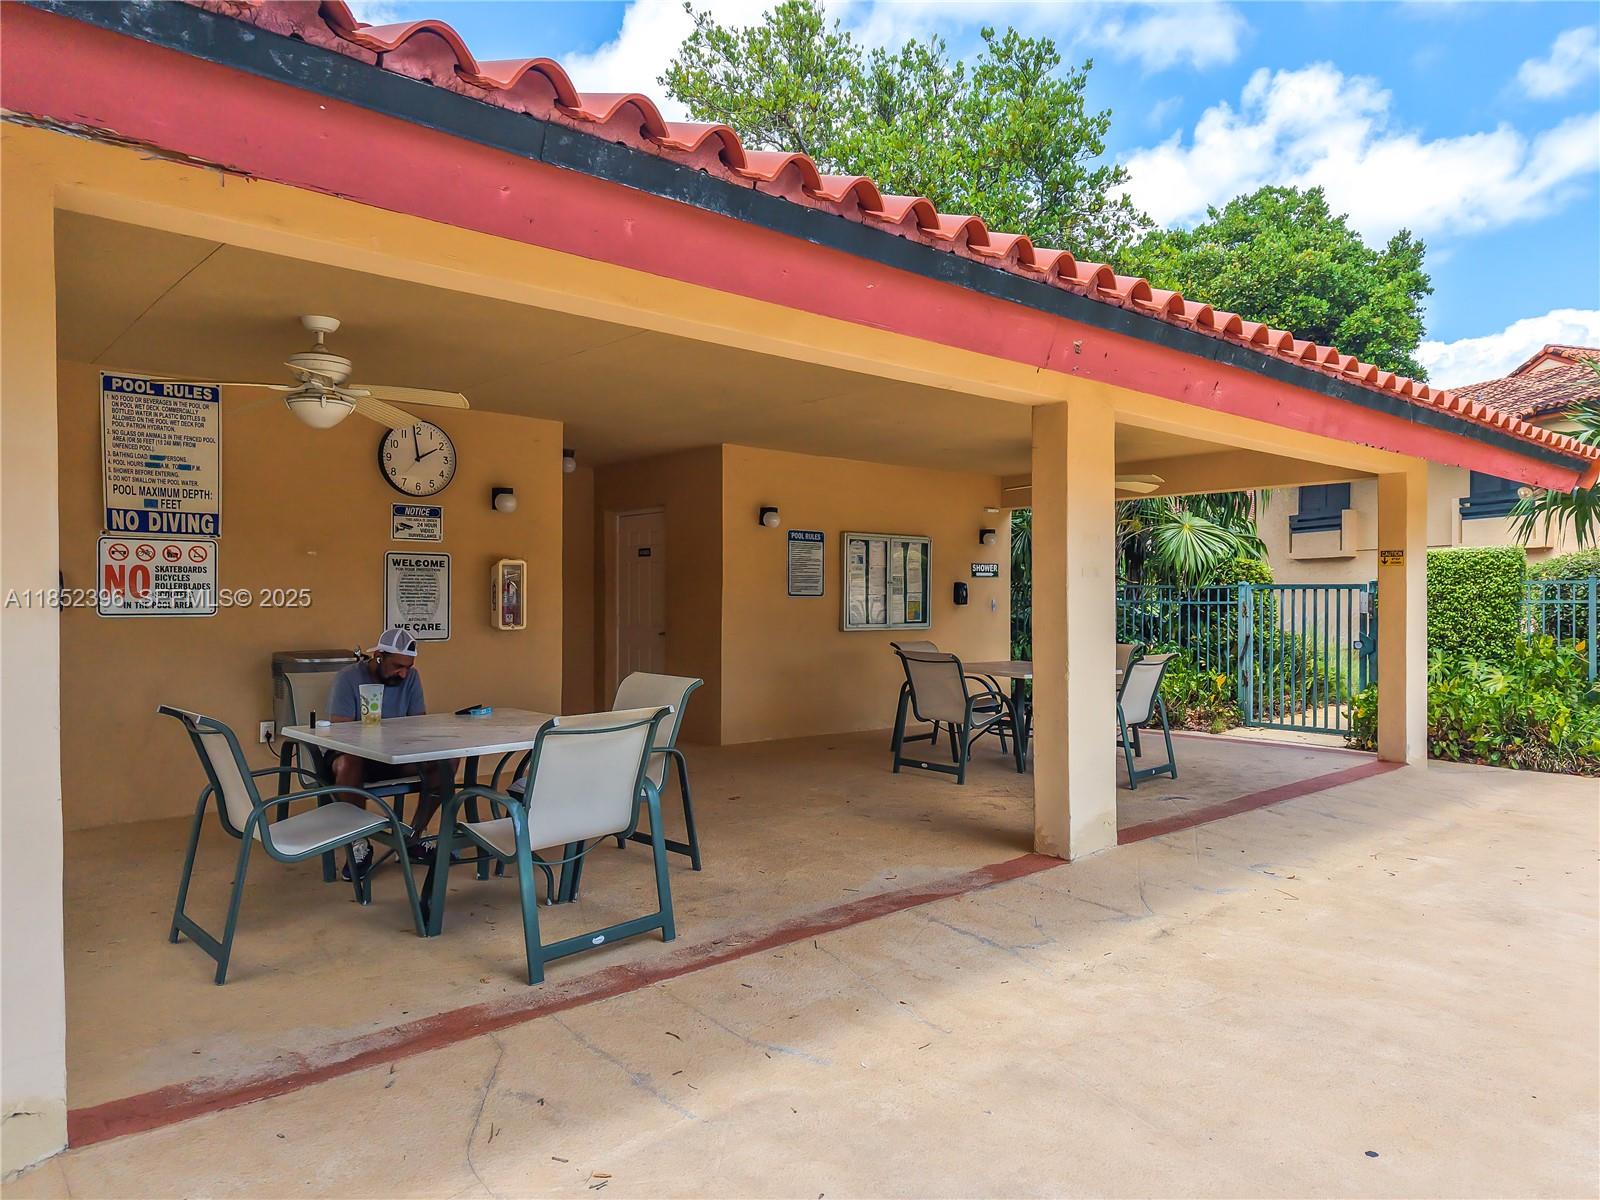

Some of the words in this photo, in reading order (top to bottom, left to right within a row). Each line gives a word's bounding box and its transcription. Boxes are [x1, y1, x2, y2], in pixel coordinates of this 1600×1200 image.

[112, 378, 154, 394] POOL
[164, 384, 212, 400] RULES
[143, 398, 171, 406] BEVERAGES
[162, 406, 198, 414] COMMERCIALLY
[401, 430, 407, 438] 11
[390, 440, 399, 449] 10
[439, 442, 444, 451] 2
[386, 453, 392, 461] 9
[443, 456, 449, 464] 3
[391, 467, 396, 476] 8
[439, 470, 444, 478] 4
[402, 478, 407, 486] 7
[429, 480, 435, 488] 5
[113, 484, 136, 496] POOL
[139, 486, 180, 498] MAXIMUM
[182, 489, 213, 500] DEPTH:
[161, 500, 182, 510] FEET
[405, 507, 431, 516] NOTICE
[112, 510, 140, 530] NO
[148, 512, 214, 534] DIVING
[392, 559, 446, 568] WELCOME
[155, 566, 208, 574] SKATEBOARDS
[105, 564, 151, 598] NO
[413, 624, 441, 632] CARE
